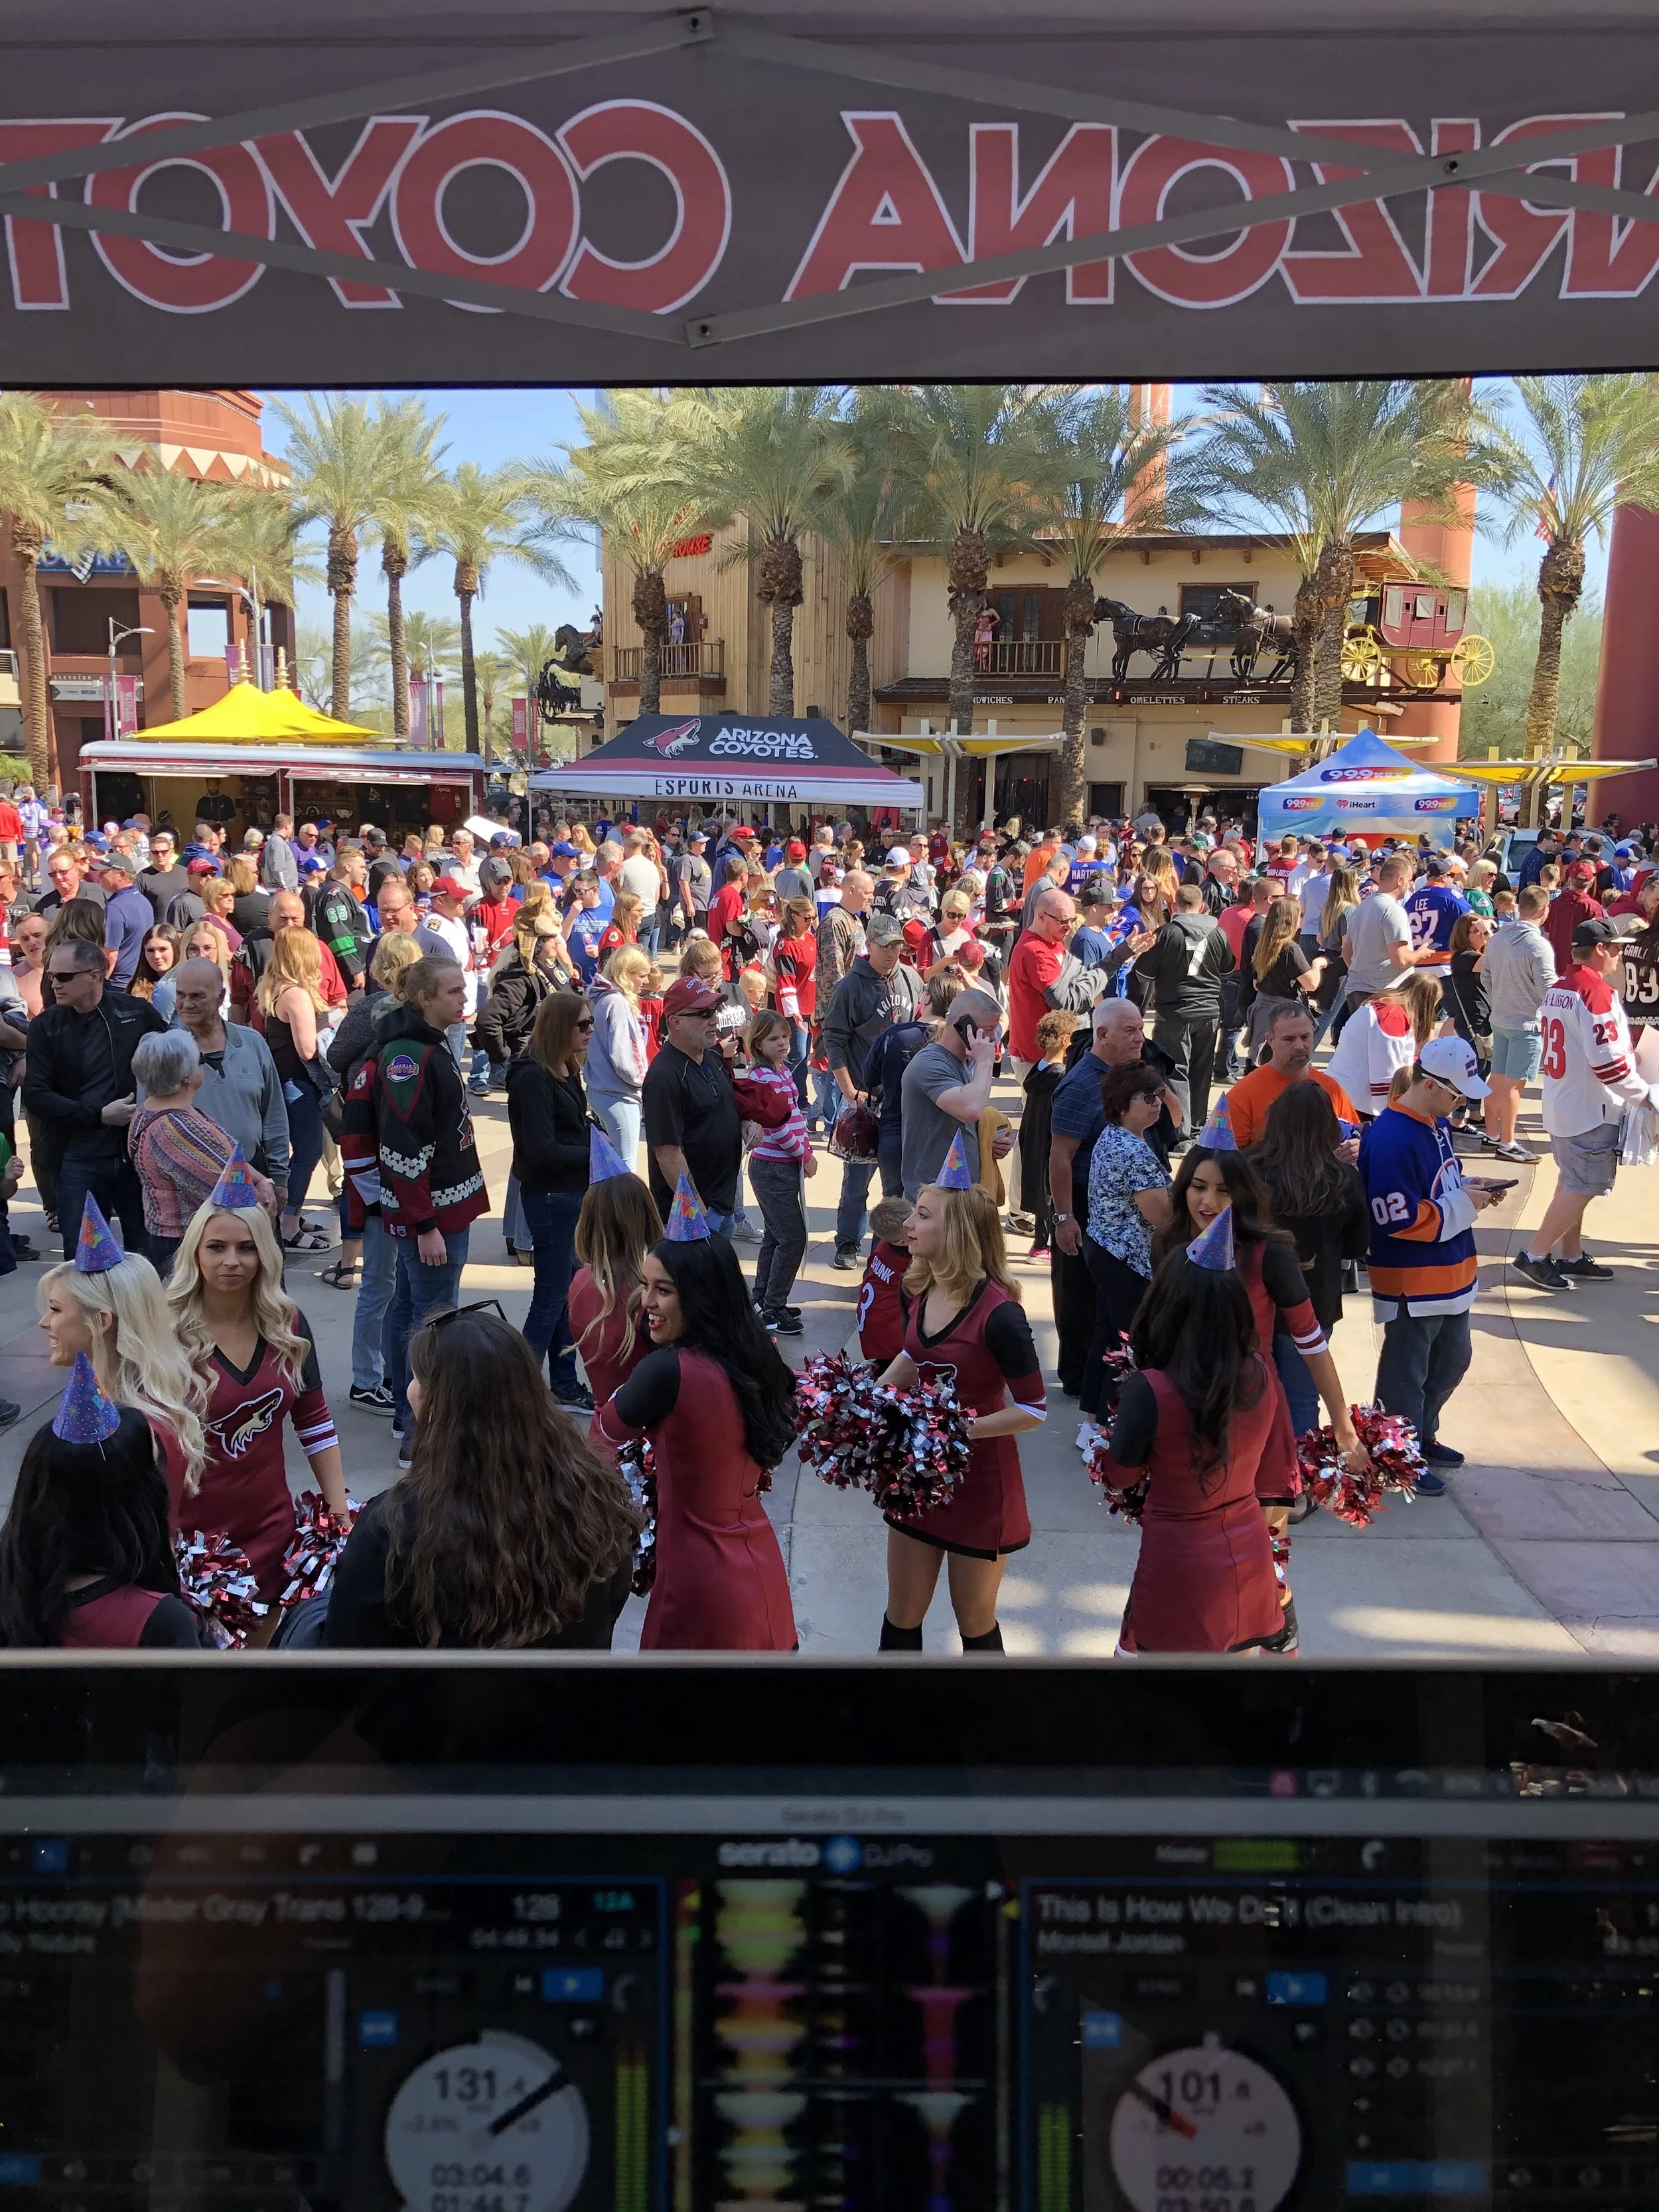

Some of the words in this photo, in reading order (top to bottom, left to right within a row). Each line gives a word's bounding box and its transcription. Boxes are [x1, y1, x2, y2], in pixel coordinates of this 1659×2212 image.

[715, 727, 813, 747] ARIZONA
[655, 779, 734, 796] ESPORTS
[743, 783, 797, 799] ARENA
[326, 905, 348, 923] 65
[1415, 898, 1429, 911] LEE
[1625, 962, 1659, 1003] 83
[877, 994, 912, 1019] ARIZONA
[1593, 1020, 1619, 1046] 23
[1371, 1191, 1409, 1226] 02
[1036, 1891, 1091, 1923] This
[1124, 1893, 1185, 1923] How
[1189, 1894, 1233, 1923] We
